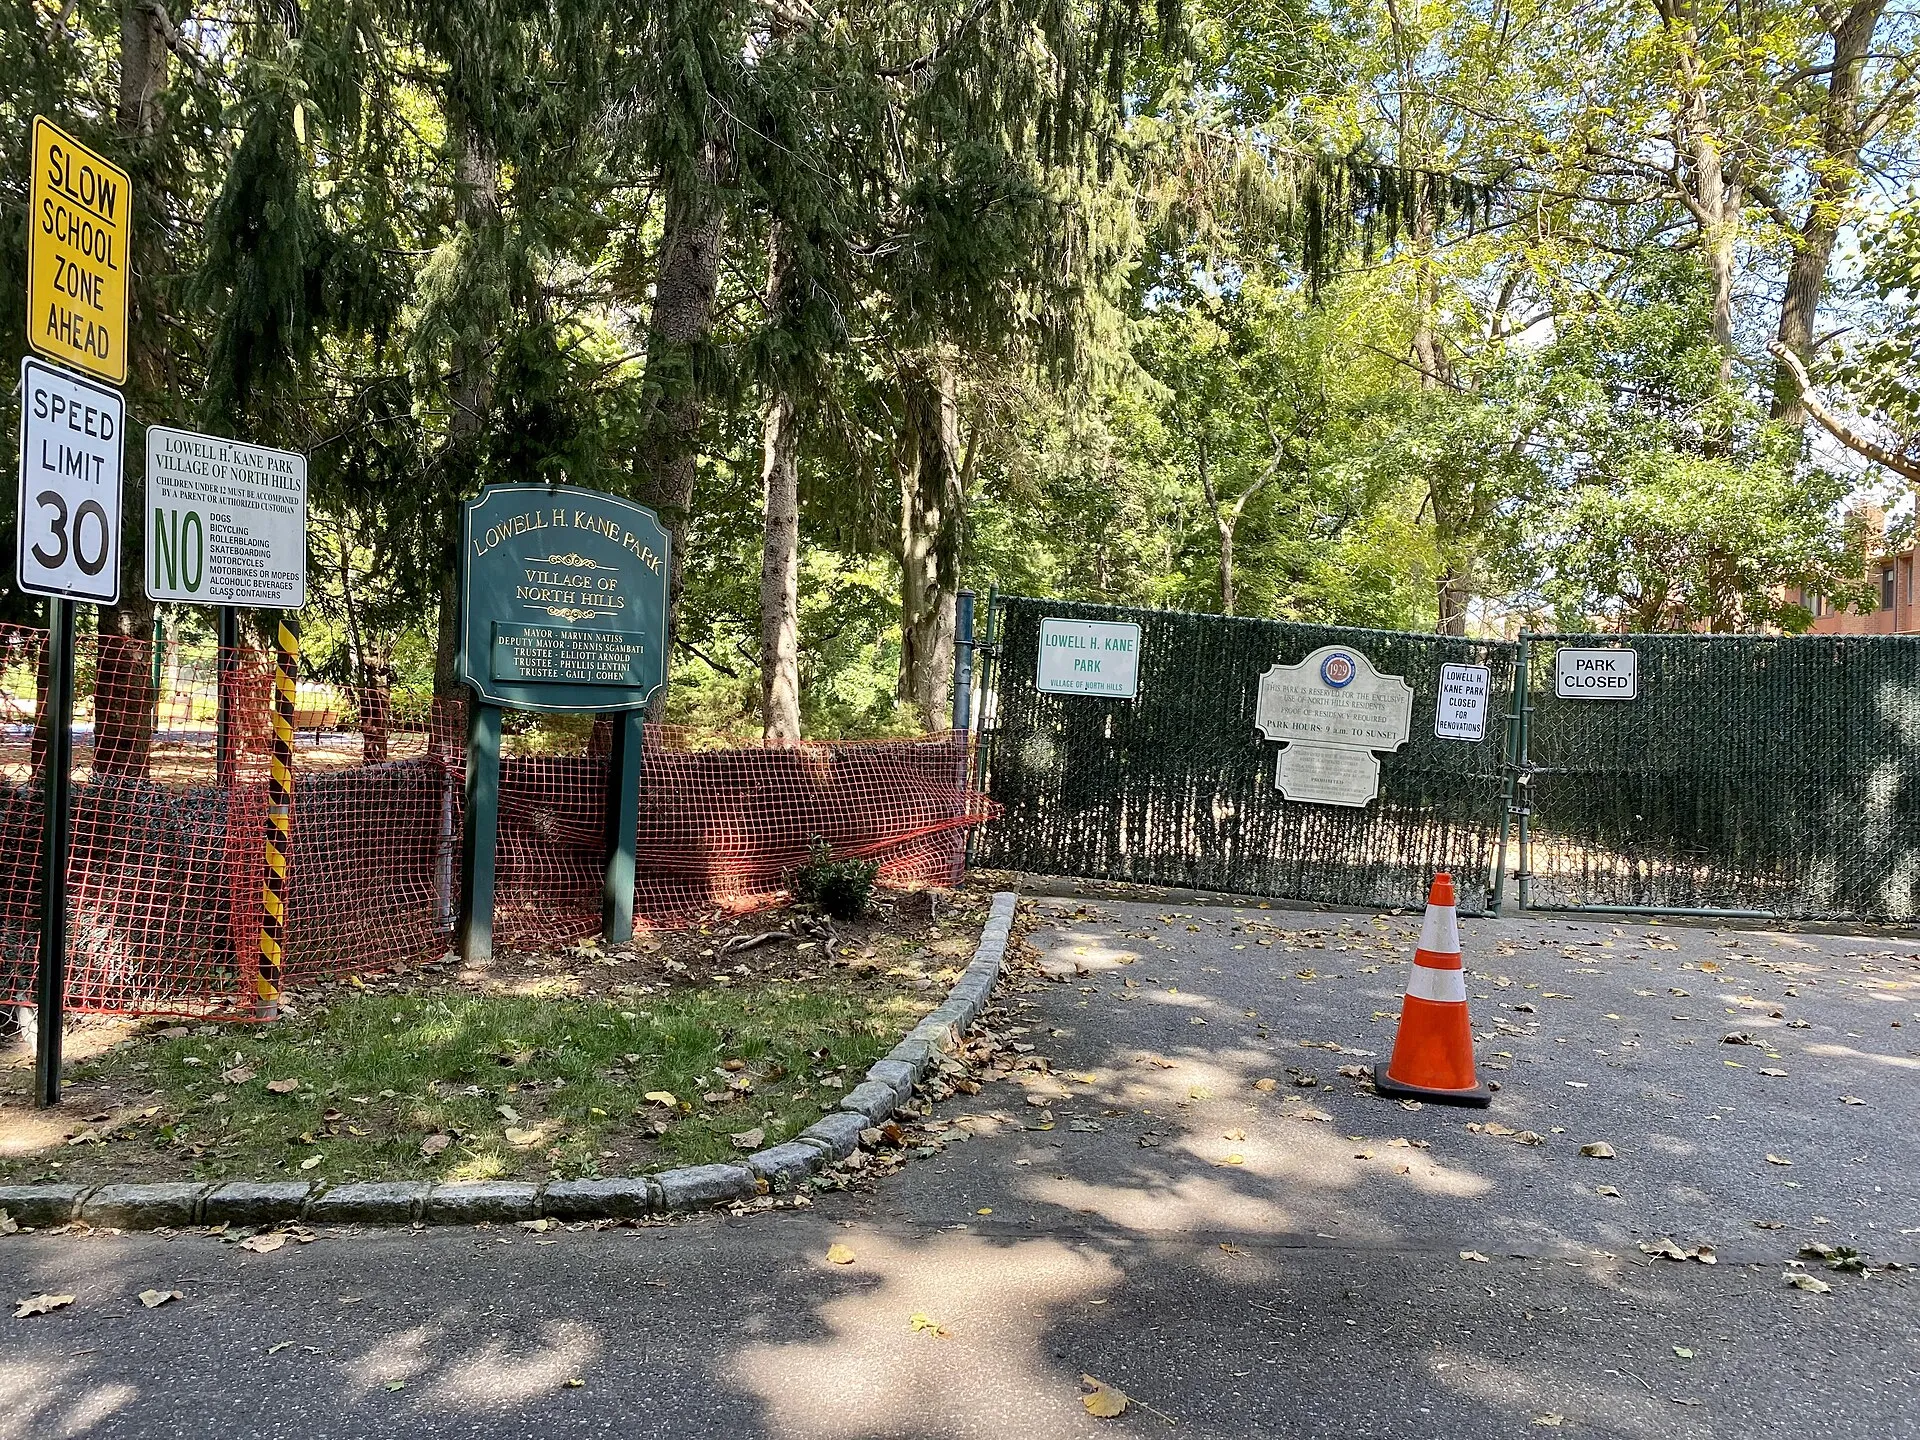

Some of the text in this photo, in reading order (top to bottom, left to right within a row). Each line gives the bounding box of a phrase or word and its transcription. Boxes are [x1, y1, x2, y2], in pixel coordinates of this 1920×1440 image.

[48, 145, 116, 219] SLOW
[42, 198, 117, 270] SCHOOL
[54, 255, 104, 311] ZONE
[47, 303, 109, 359] AHEAD
[34, 389, 114, 441] SPEED
[43, 439, 104, 484] LIMIT
[166, 438, 293, 474] LOWELL H. KANE PARK
[156, 454, 301, 491] VILLAGE OF NORTH HILLS
[156, 476, 193, 489] CHILDREN
[195, 482, 218, 493] UNDER
[228, 488, 245, 497] MUST
[247, 490, 255, 498] BE
[256, 491, 299, 505] ACCOMPANIED
[162, 488, 171, 496] BY
[180, 491, 206, 502] PARENT
[207, 495, 217, 503] OR
[218, 496, 259, 509] AUTHORIZED
[261, 503, 294, 514] CUSTODIAN
[210, 513, 231, 523] DOGS
[32, 491, 109, 575] 30
[210, 524, 248, 535] BICYCLING
[210, 534, 269, 548] ROLLERBLADING
[473, 509, 663, 576] LOWELL H. KANE PARK
[155, 508, 203, 592] NO
[210, 545, 270, 558] SKATEBOARDING
[210, 555, 264, 567] MOTORCYCLES
[210, 566, 299, 580] MOTORBIKES OR MOPEDS
[210, 577, 292, 590] ALCOHOLIC BEVERAGES
[525, 570, 618, 591] VILLAGE OF
[210, 587, 280, 599] GLASS CONTAINERS
[517, 586, 624, 608] NORTH HILLS
[524, 629, 552, 638] MAYOR
[561, 631, 592, 640] MARVIN
[596, 634, 622, 642] NATISS
[1046, 634, 1133, 651] LOWELL H. KANE
[499, 637, 532, 646] DEPUTY
[536, 640, 564, 648] MAYOR
[573, 642, 602, 651] DENNIS
[605, 644, 643, 653] SGAMBATI
[514, 648, 552, 658] TRUSTEE
[561, 651, 596, 659] ELLIOTT
[598, 654, 630, 662] ARNOLD
[514, 658, 552, 667] TRUSTEE
[560, 661, 594, 669] PHYLLIS
[597, 663, 630, 671] LENTINI
[1074, 659, 1100, 672] PARK
[1330, 664, 1347, 676] 1929
[1577, 660, 1615, 671] PARK
[520, 668, 558, 677] TRUSTEE
[588, 672, 593, 681] J.
[596, 672, 624, 680] COHEN
[1447, 672, 1473, 682] LOWELL
[1565, 676, 1627, 687] CLOSED
[1309, 688, 1339, 696] RESERVED
[1372, 694, 1404, 703] EXCLUSIVE
[1444, 684, 1483, 695] KANE PARK
[1308, 697, 1328, 705] NORTH
[1352, 702, 1385, 711] RESIDENTS
[1449, 698, 1476, 708] CLOSED
[1281, 706, 1301, 714] PROOF
[1315, 710, 1349, 720] RESIDENCY
[1353, 714, 1386, 723] REQUIRED
[1456, 711, 1467, 719] FOR
[1267, 720, 1288, 729] PARK
[1352, 728, 1362, 736] TO
[1366, 730, 1397, 739] SUNSET
[1440, 721, 1480, 732] RENOVATIONS
